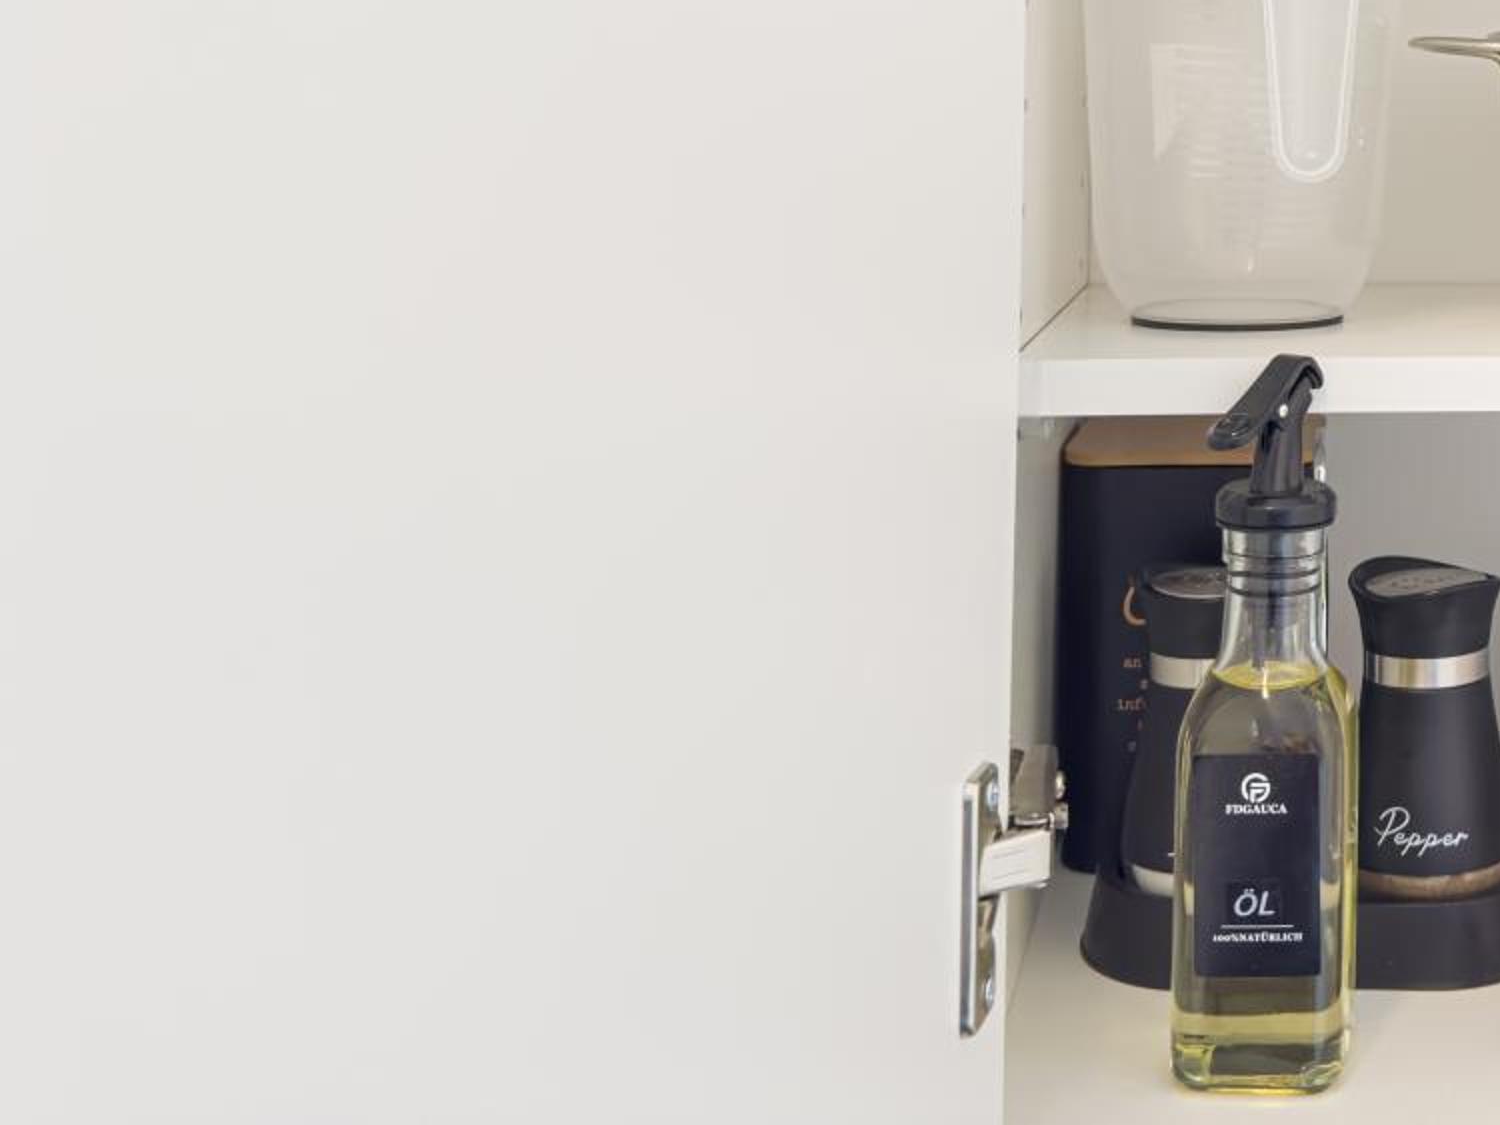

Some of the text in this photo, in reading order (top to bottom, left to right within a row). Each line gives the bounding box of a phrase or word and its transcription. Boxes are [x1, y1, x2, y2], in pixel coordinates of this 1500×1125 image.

[1225, 804, 1288, 815] FDGAUCA
[1374, 806, 1469, 857] Pepper
[1233, 888, 1276, 917] ÖL
